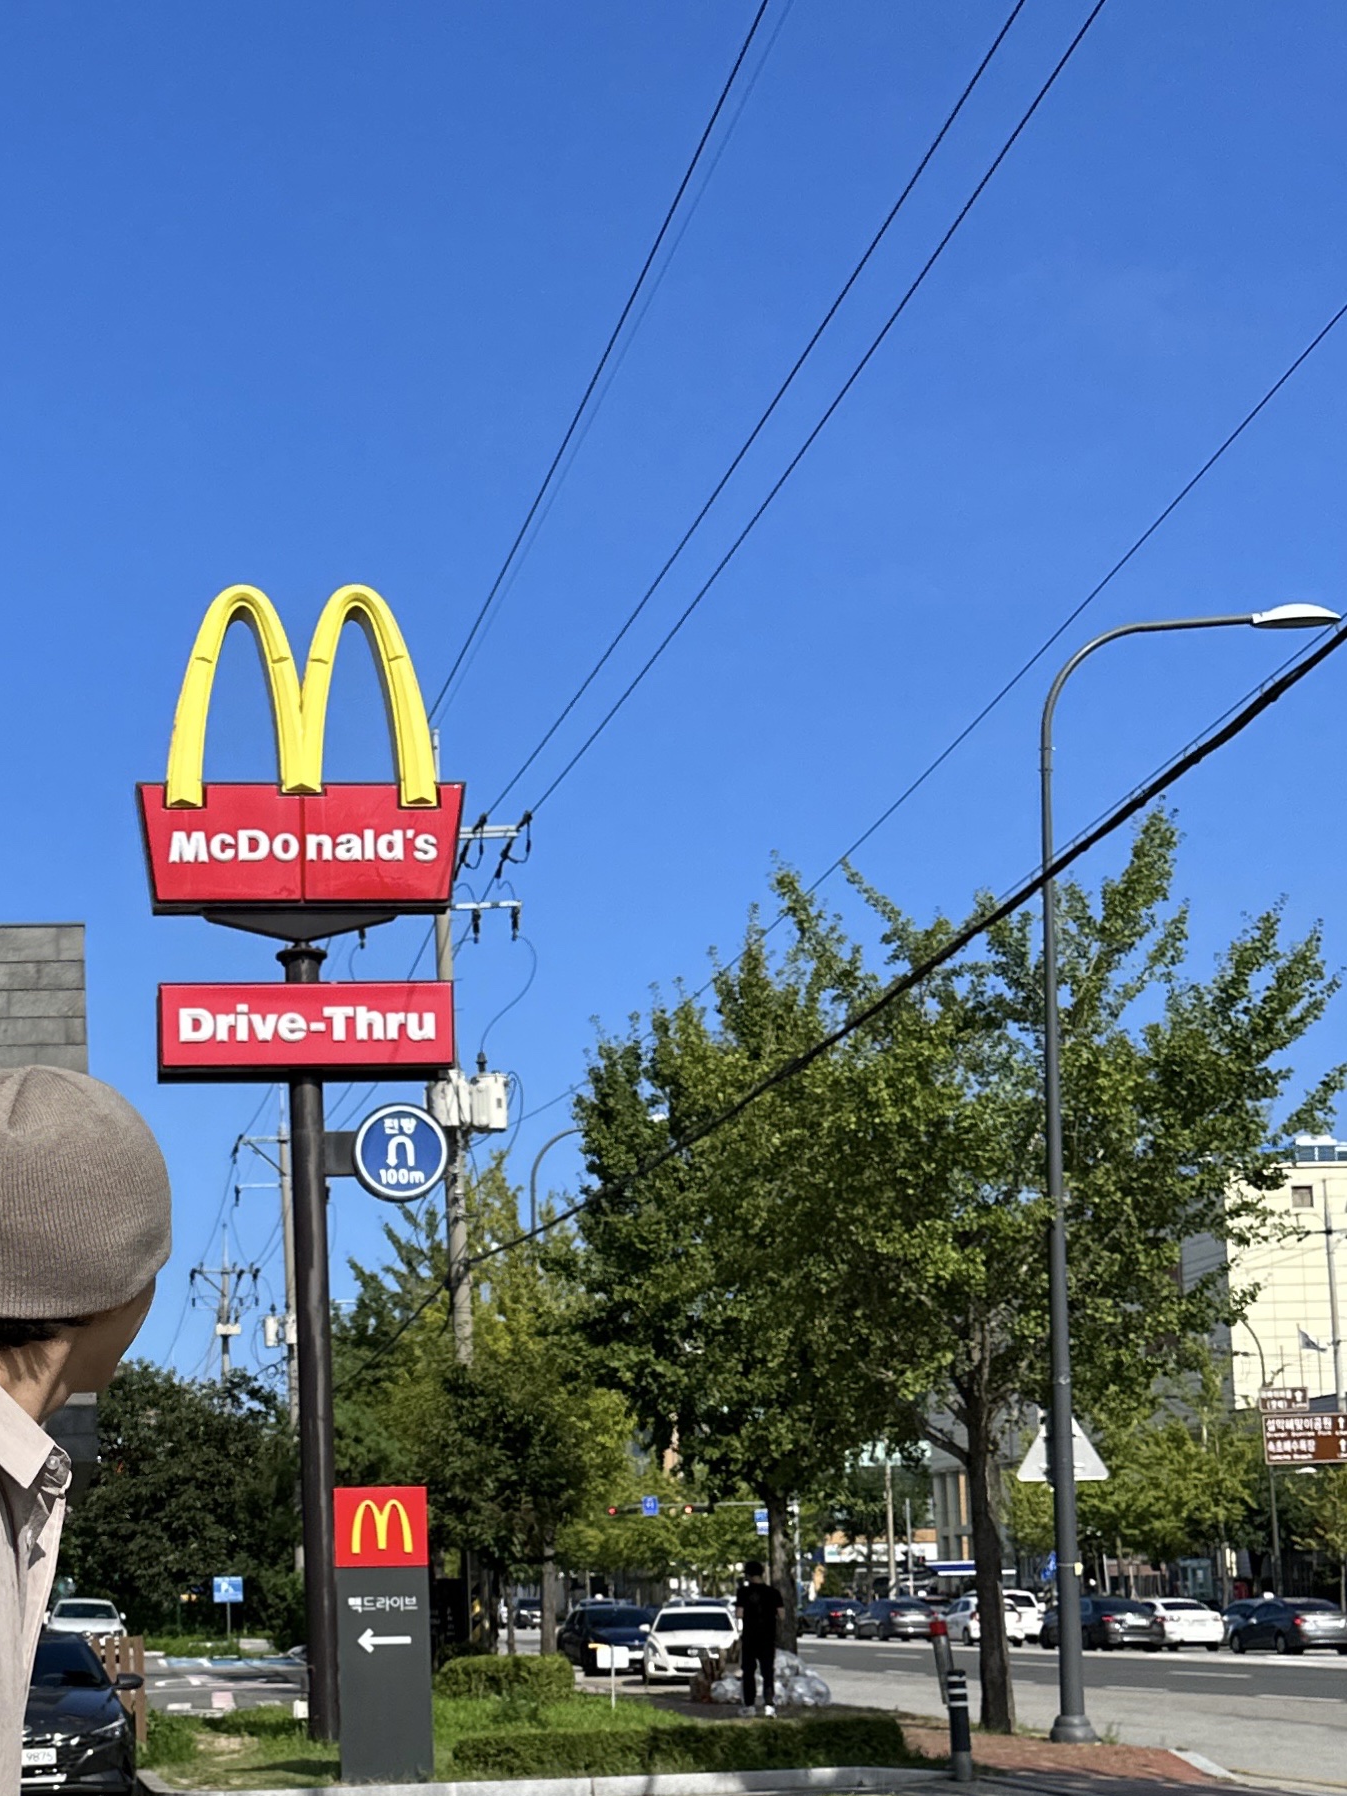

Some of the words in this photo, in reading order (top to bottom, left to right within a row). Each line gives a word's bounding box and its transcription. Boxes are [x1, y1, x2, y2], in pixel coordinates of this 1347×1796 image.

[168, 827, 438, 864] McDonald's
[178, 1003, 437, 1044] Drive-Thru
[383, 1117, 417, 1135] 전방
[378, 1168, 426, 1185] 100m
[347, 1595, 419, 1614] 맥드라이브
